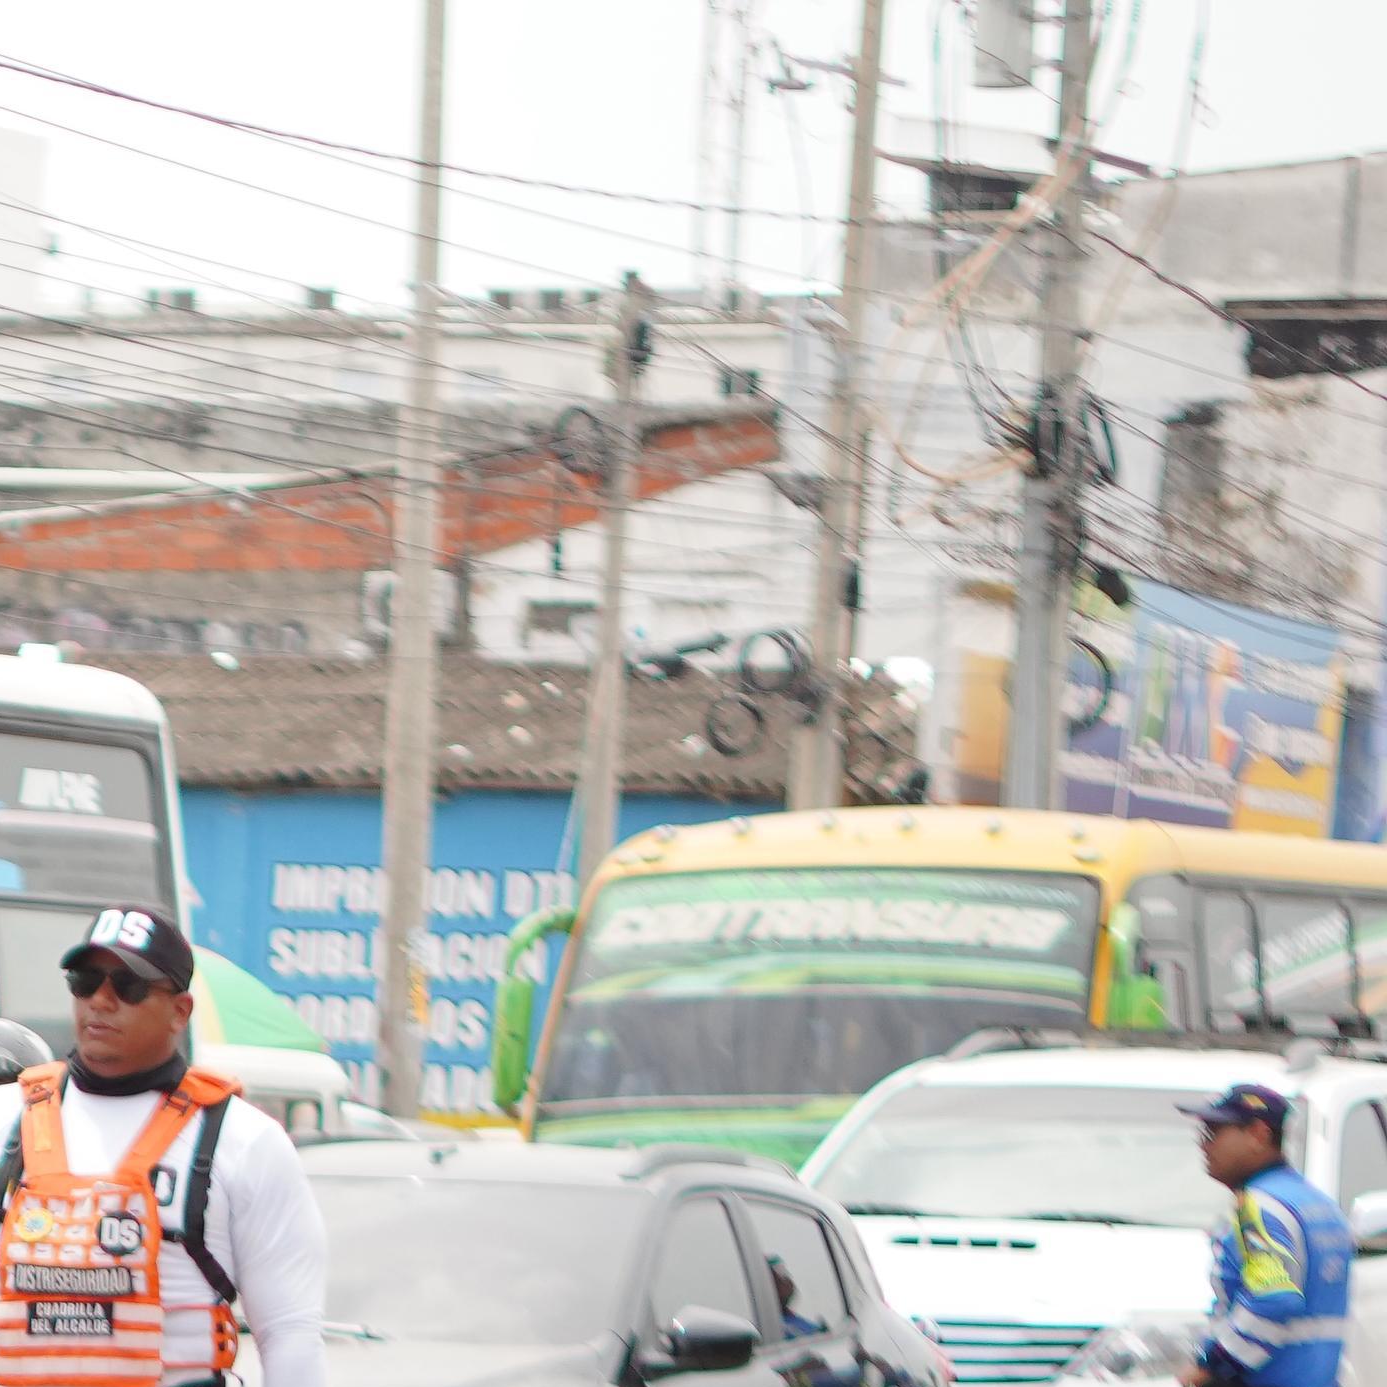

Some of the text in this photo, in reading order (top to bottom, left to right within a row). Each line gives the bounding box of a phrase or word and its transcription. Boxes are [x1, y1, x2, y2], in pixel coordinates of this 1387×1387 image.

[89, 908, 156, 952] DS
[100, 1216, 142, 1250] DS
[16, 1264, 132, 1297] DISTRISEGURIDAD
[35, 1302, 105, 1318] CUADRILLA
[31, 1318, 112, 1336] DEL ALCALDE
